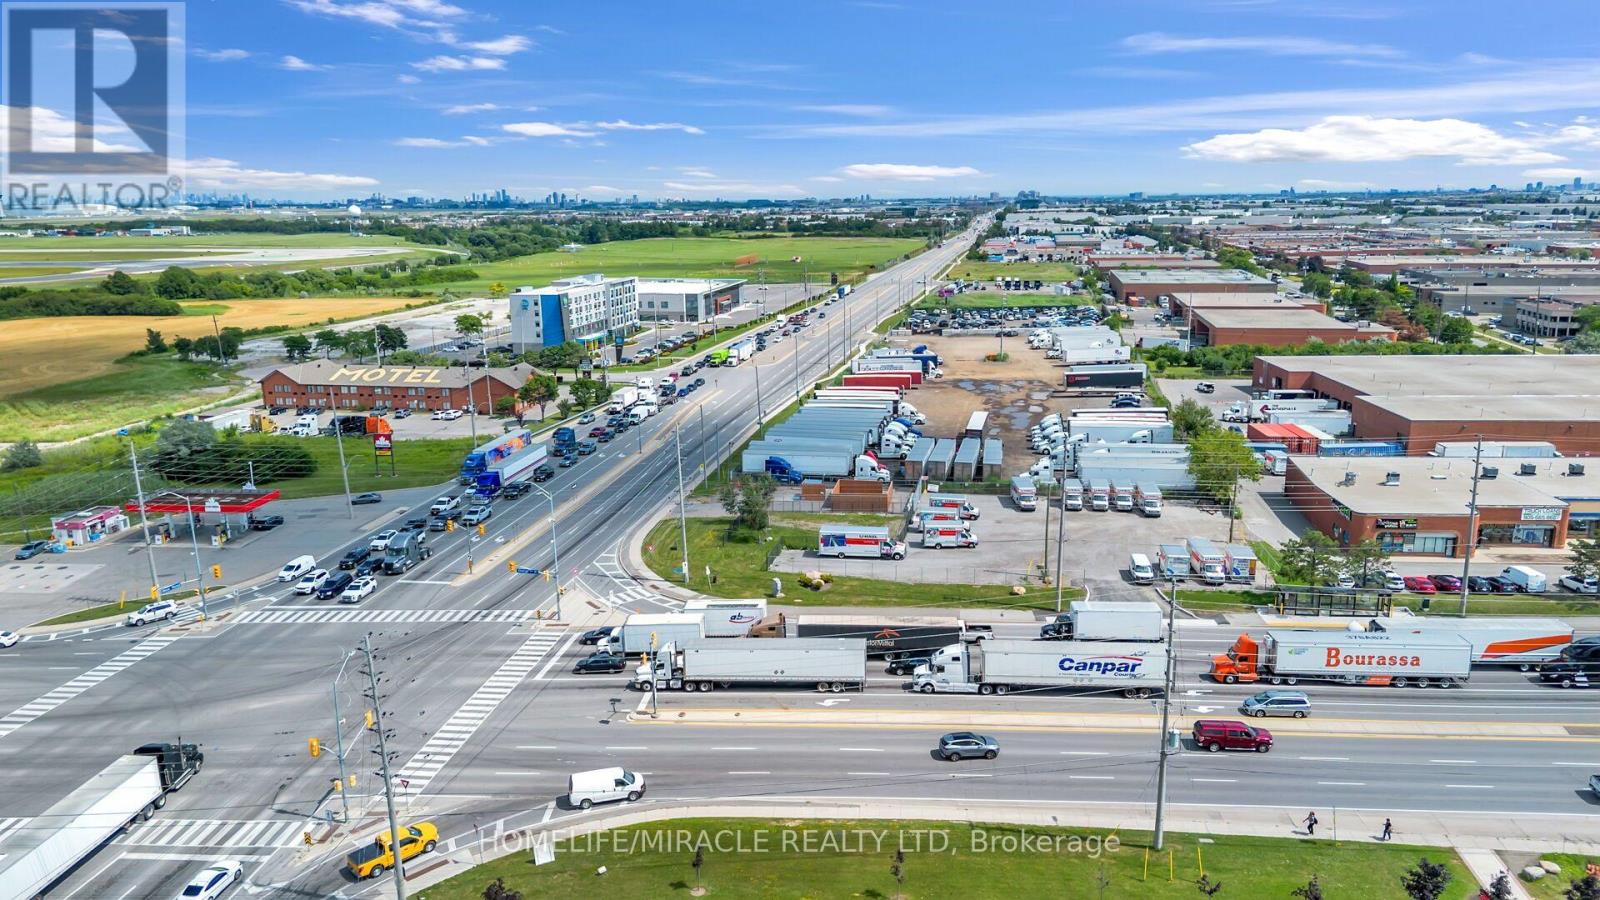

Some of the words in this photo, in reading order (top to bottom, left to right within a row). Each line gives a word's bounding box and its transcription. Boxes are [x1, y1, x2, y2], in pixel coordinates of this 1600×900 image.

[328, 367, 441, 383] MOTEL
[1058, 657, 1142, 674] Canpar
[1325, 647, 1420, 667] Bourassa
